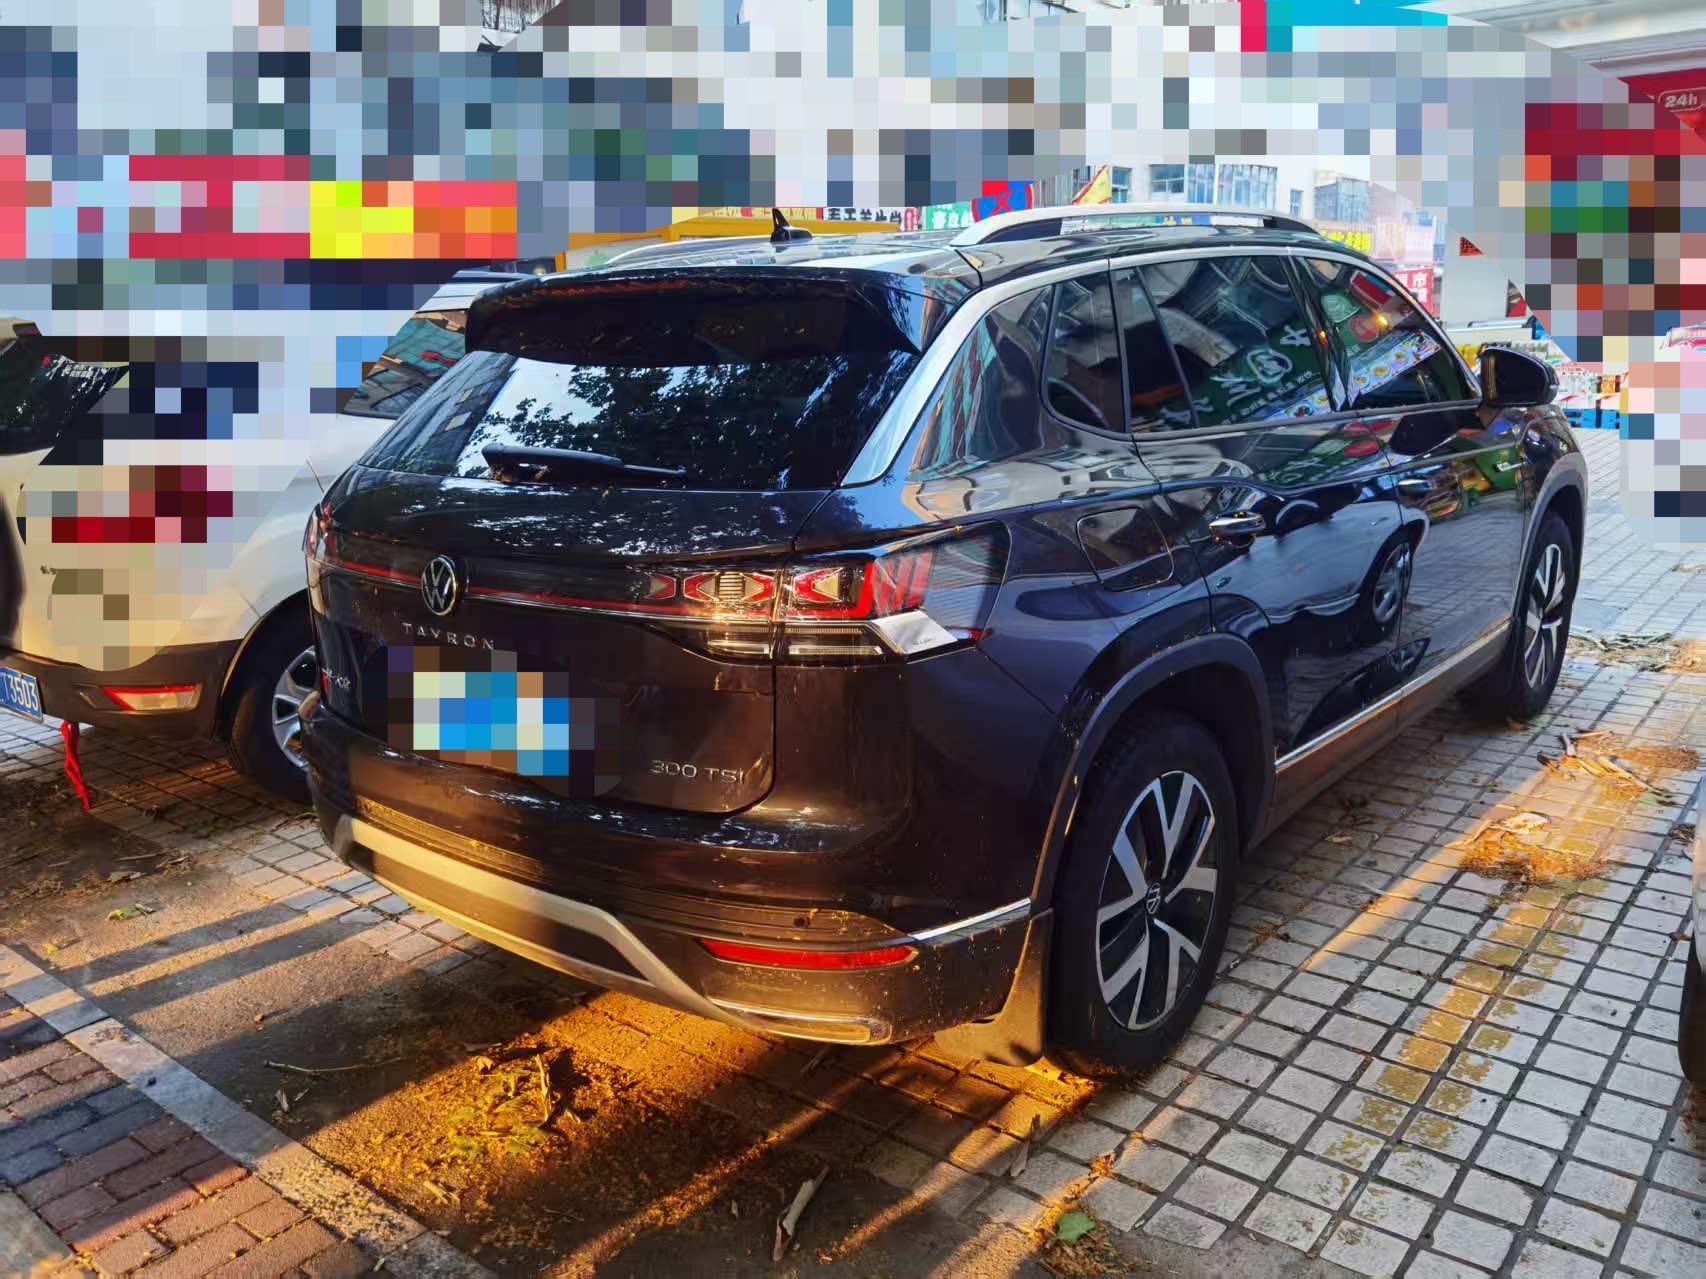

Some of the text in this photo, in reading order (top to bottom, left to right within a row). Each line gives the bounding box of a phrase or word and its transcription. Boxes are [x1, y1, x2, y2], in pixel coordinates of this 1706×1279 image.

[1665, 93, 1698, 108] 24h
[402, 622, 495, 650] TAYRON
[650, 760, 745, 784] 300 TSI
